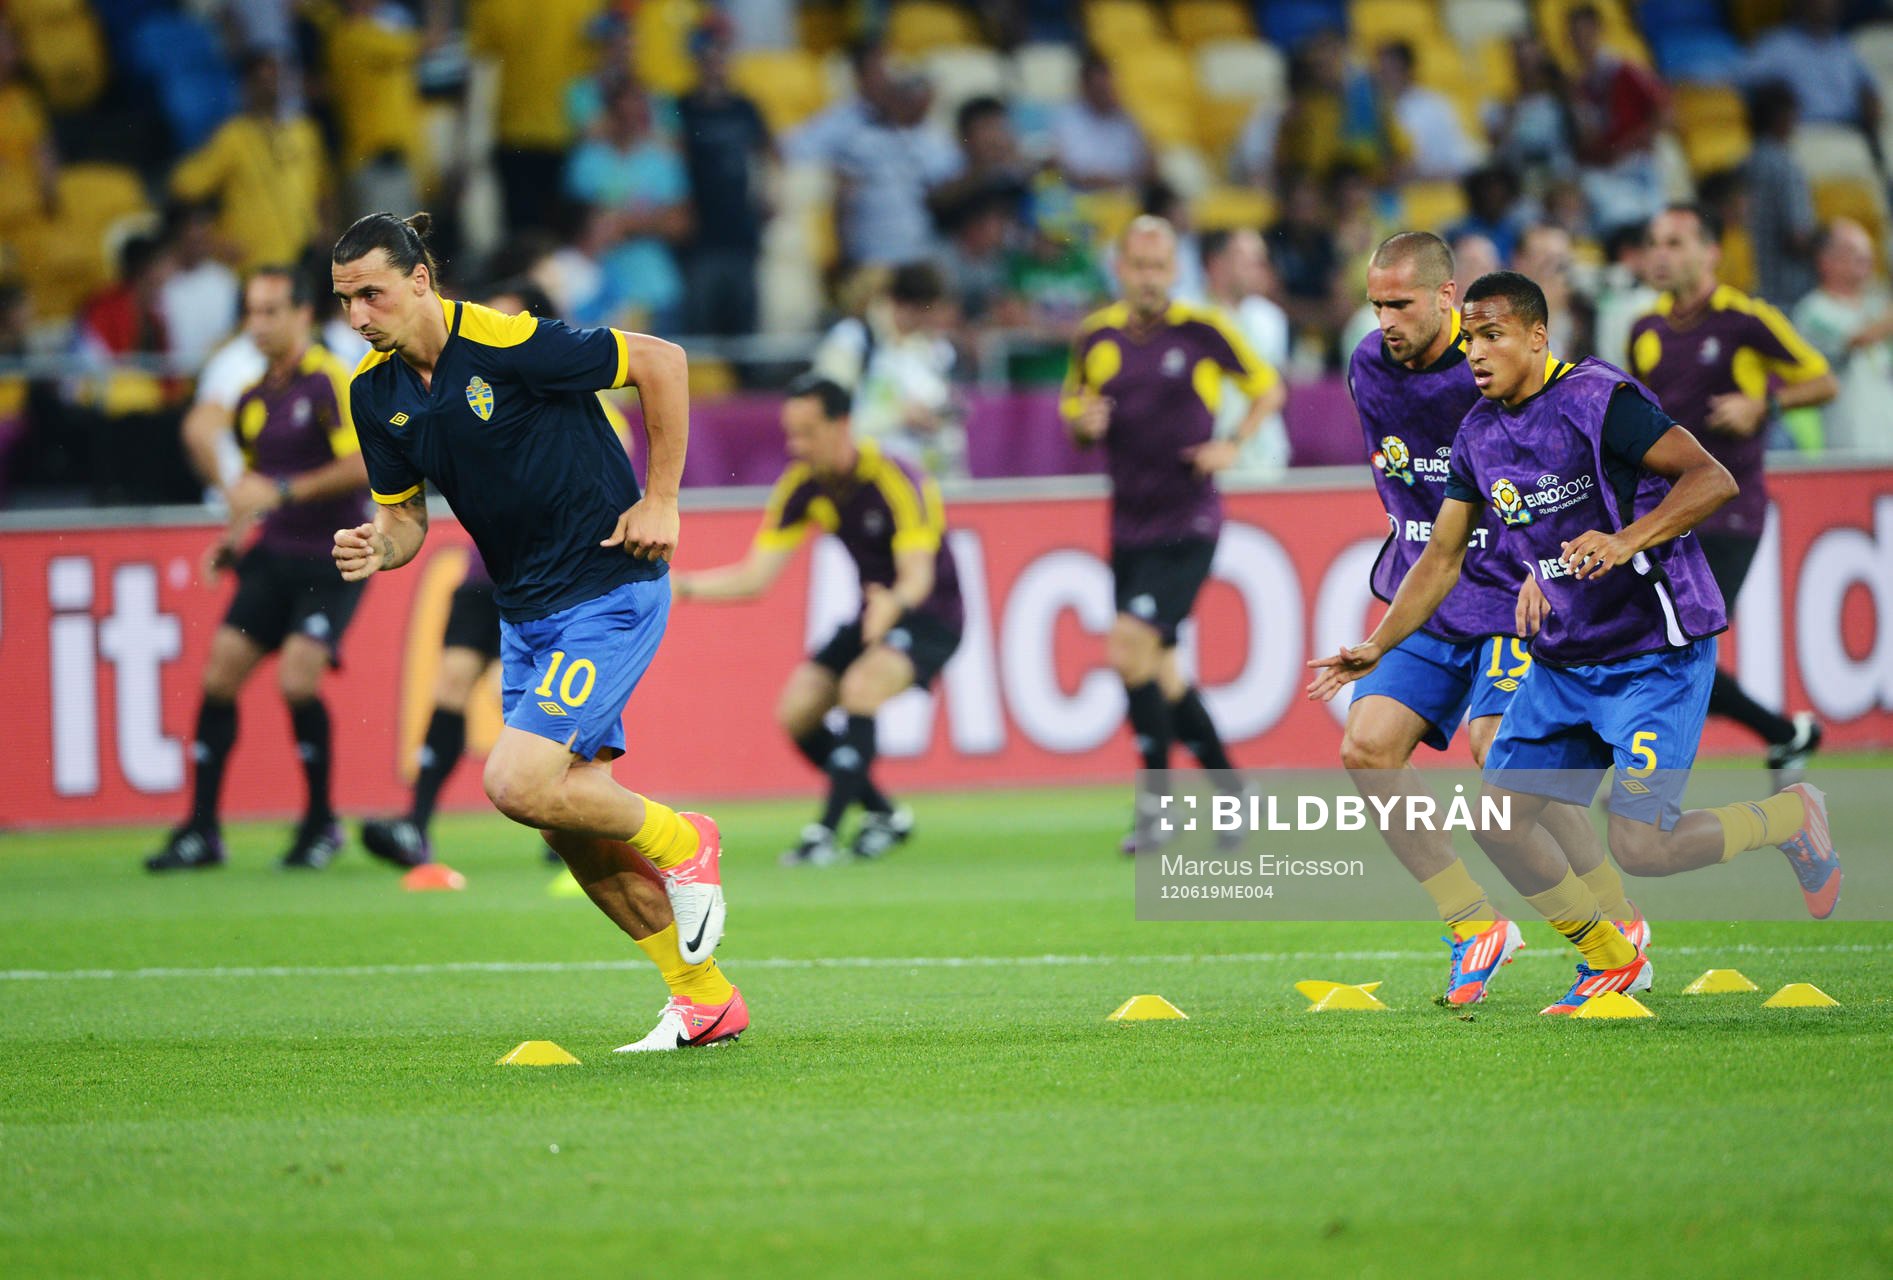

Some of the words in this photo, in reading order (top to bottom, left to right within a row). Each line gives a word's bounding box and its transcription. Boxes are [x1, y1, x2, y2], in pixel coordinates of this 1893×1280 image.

[49, 555, 186, 797] it
[534, 651, 597, 707] 10
[1486, 636, 1532, 677] 19
[1627, 731, 1657, 778] 5
